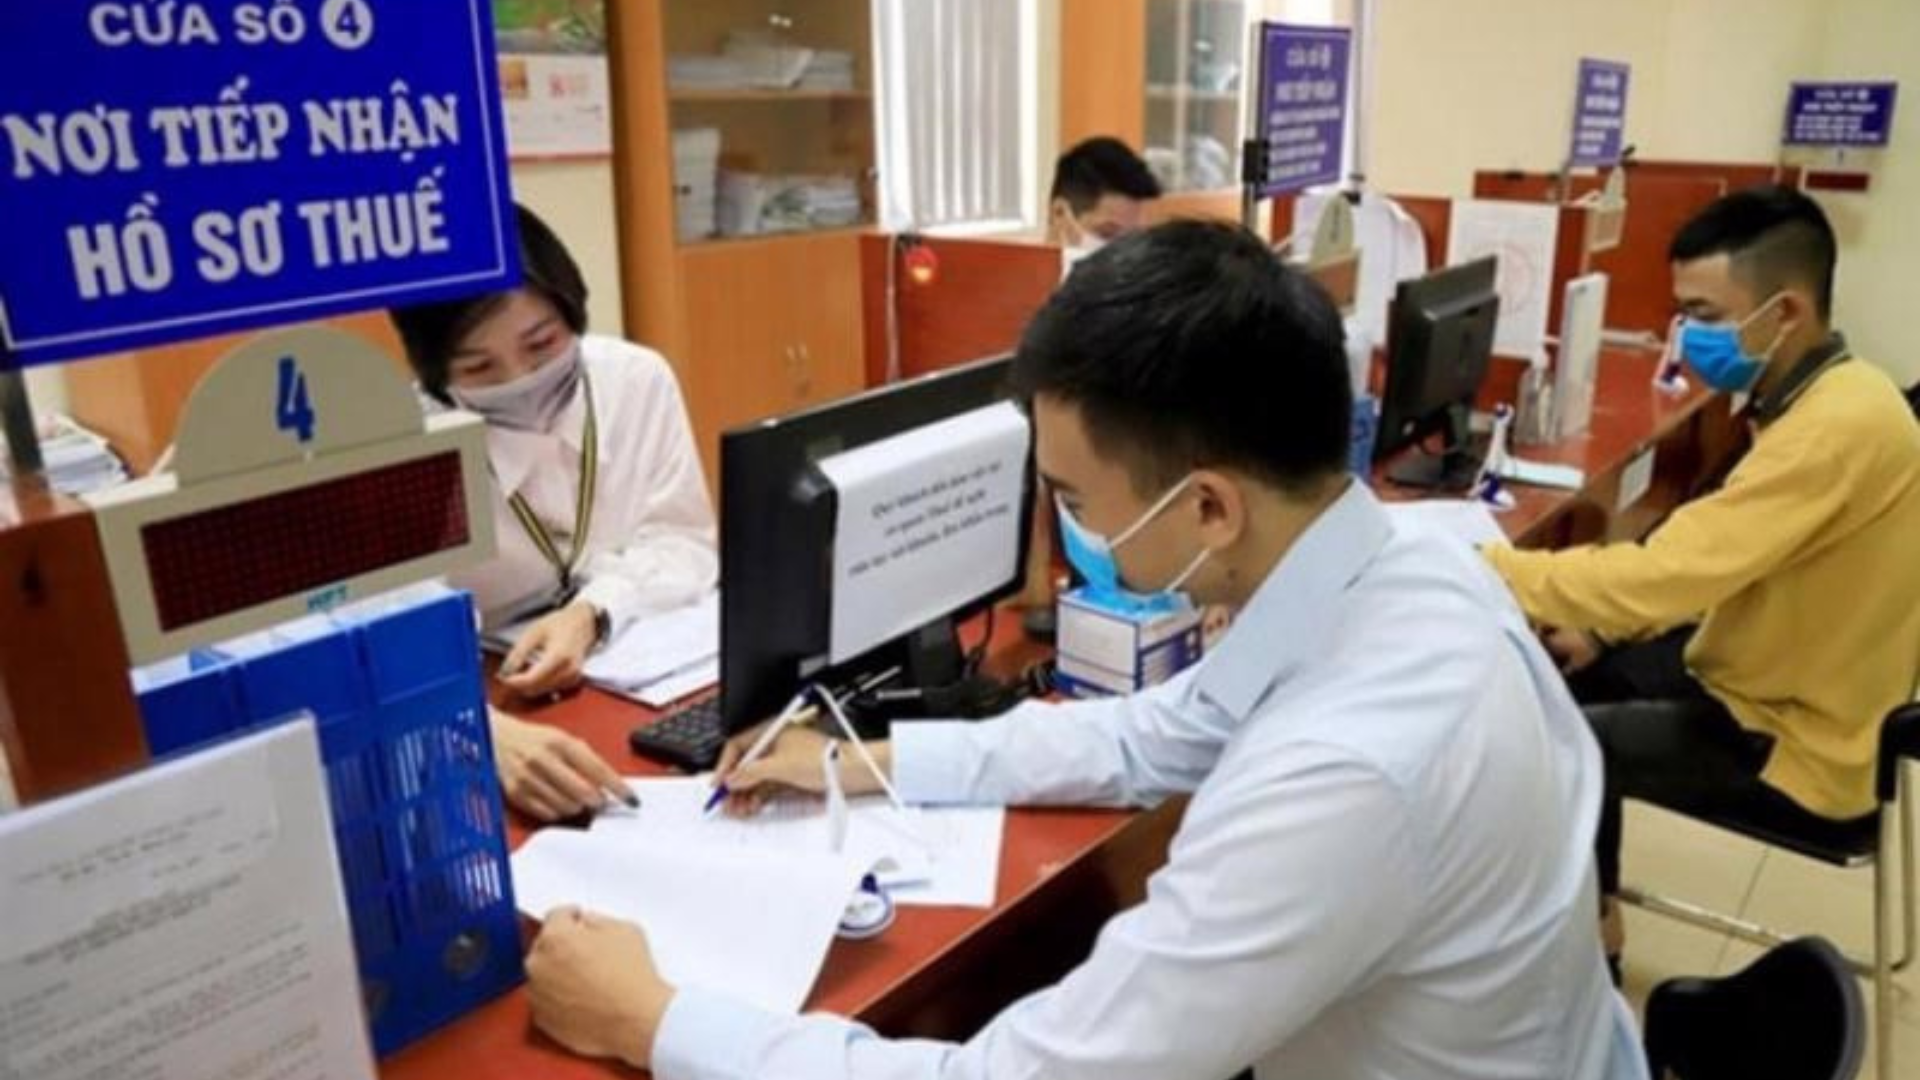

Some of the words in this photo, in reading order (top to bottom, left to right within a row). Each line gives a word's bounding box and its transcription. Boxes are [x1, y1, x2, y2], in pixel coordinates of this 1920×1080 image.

[2, 105, 140, 179] NƠI
[150, 76, 289, 167] TIẾP
[304, 79, 461, 163] NHẬN
[67, 193, 173, 299] HỒ
[192, 201, 284, 283] SƠ
[299, 167, 449, 267] THUẾ
[278, 357, 314, 442] 4
